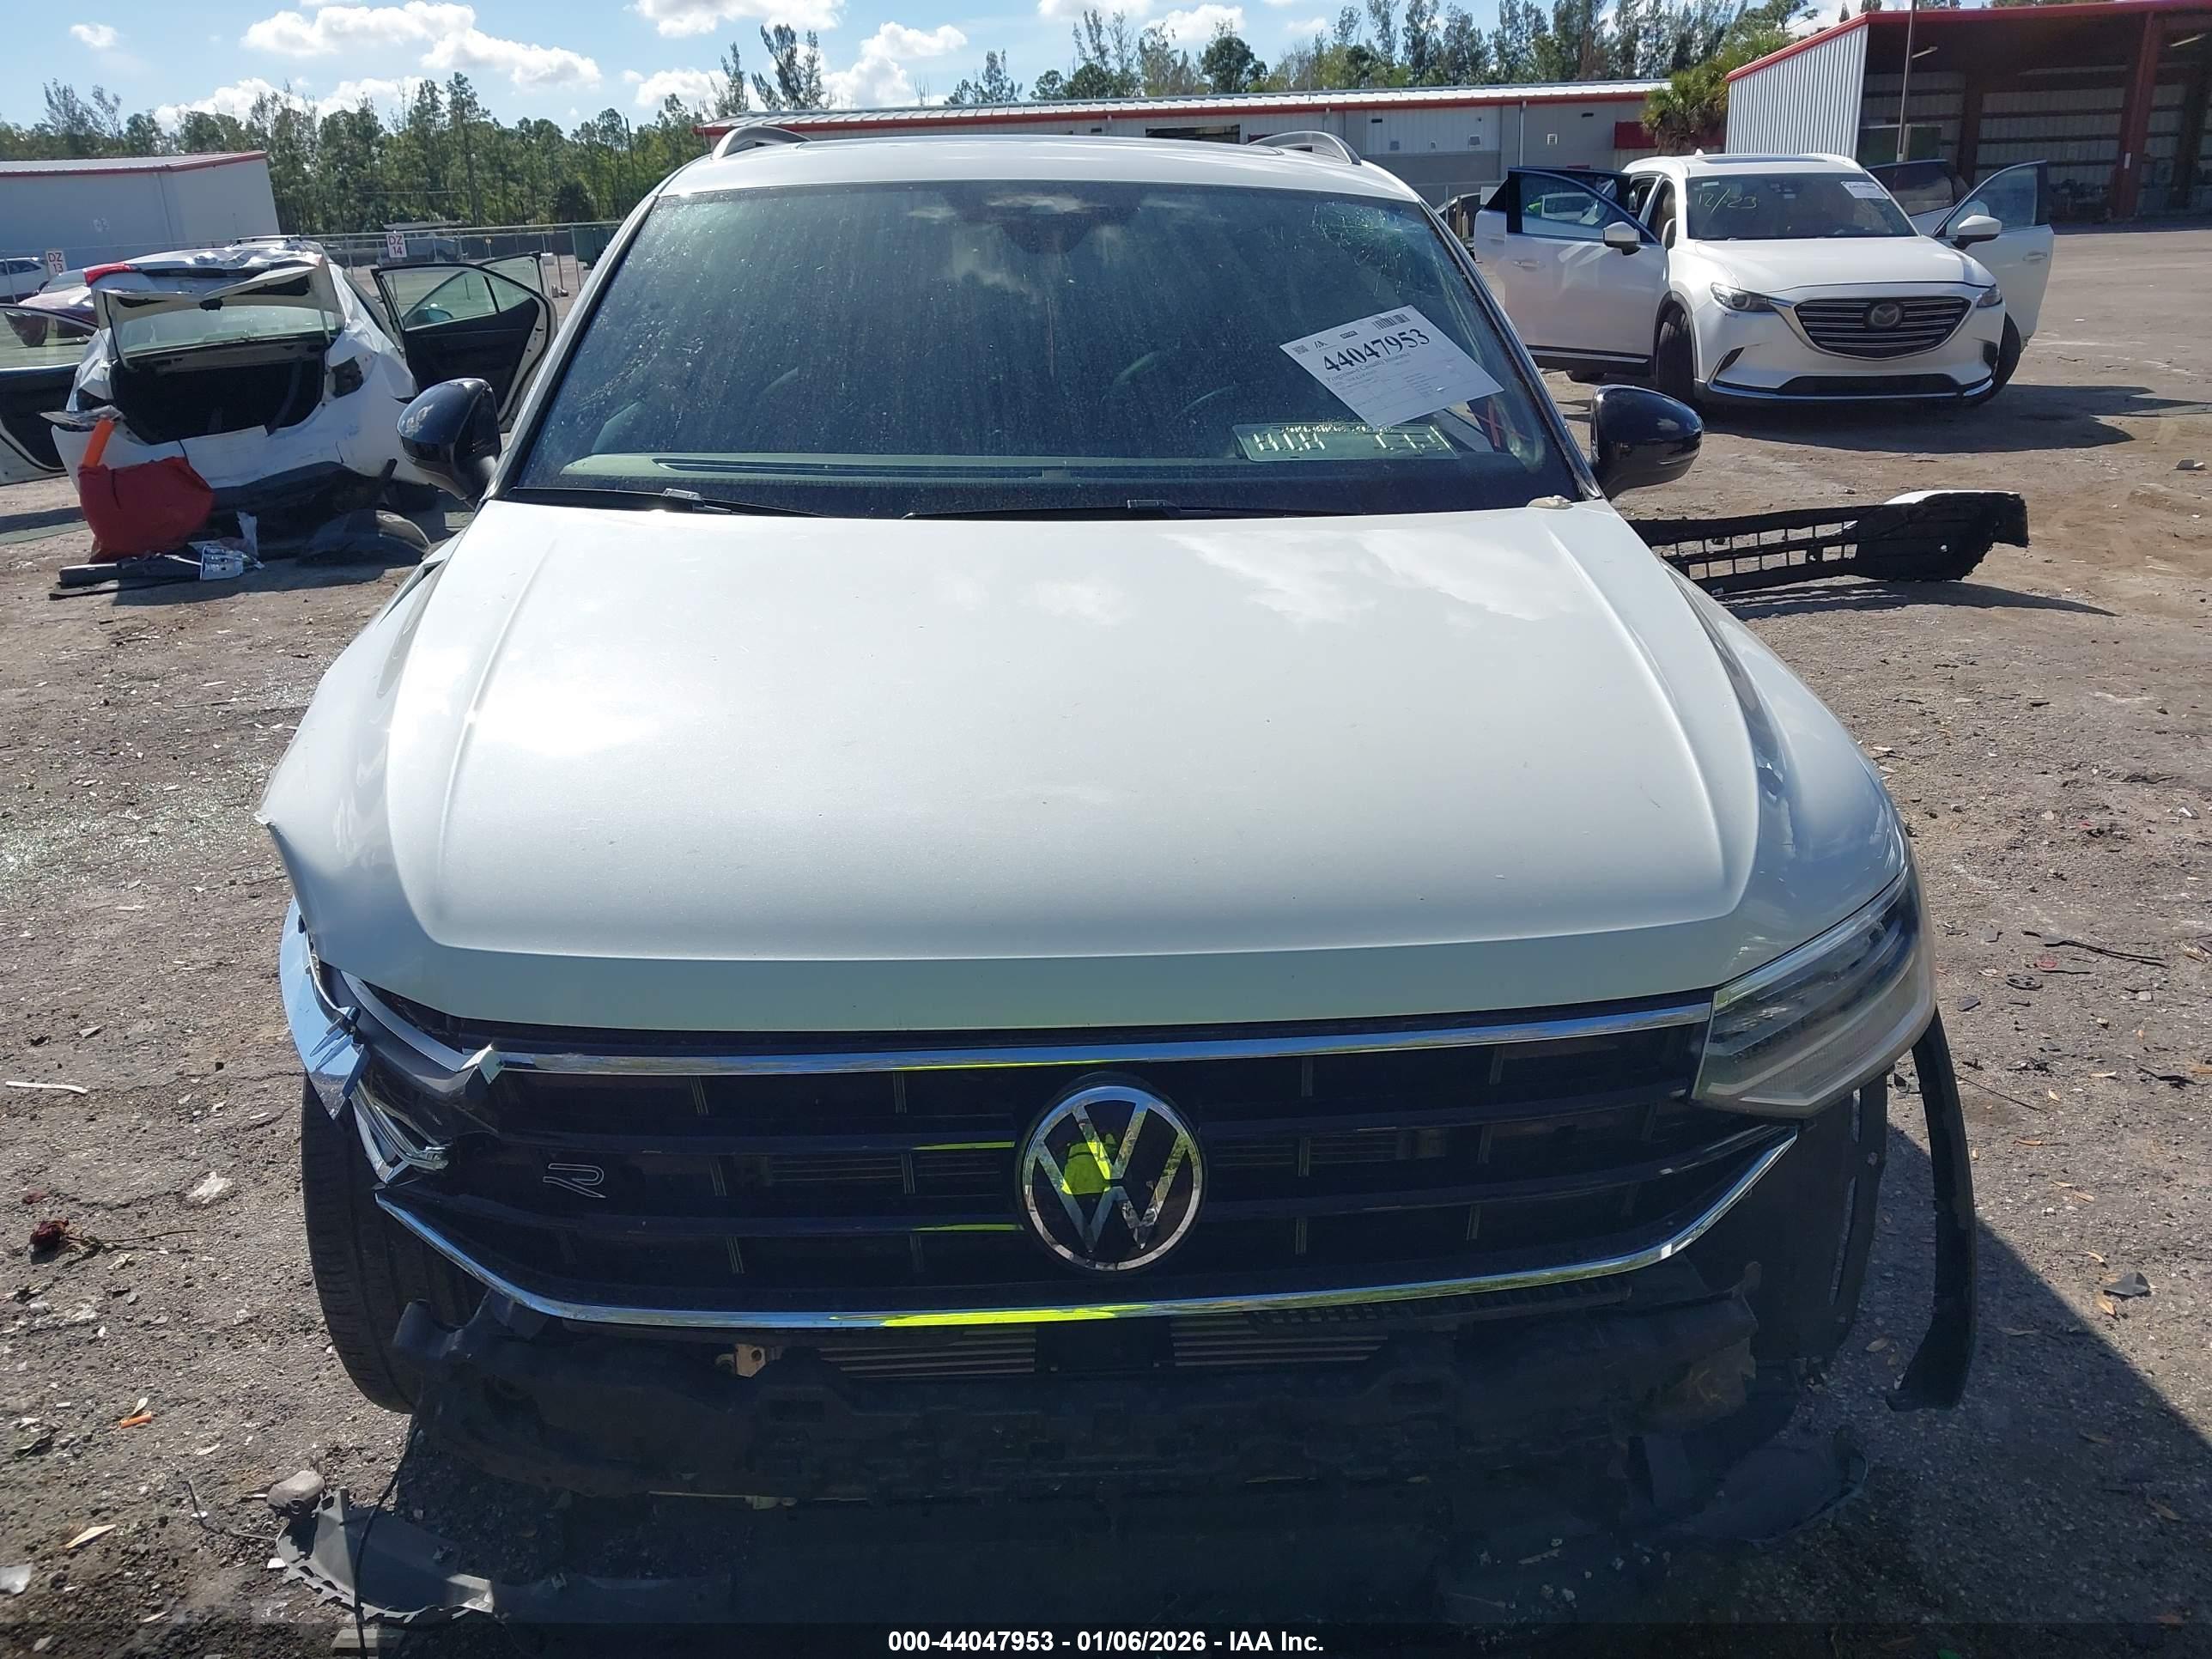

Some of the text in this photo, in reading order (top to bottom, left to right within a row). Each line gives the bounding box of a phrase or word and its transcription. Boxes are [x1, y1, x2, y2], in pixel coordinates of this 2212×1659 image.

[388, 235, 404, 245] DZ
[392, 246, 403, 255] 14
[48, 252, 63, 262] DZ
[1324, 328, 1430, 372] 44047953
